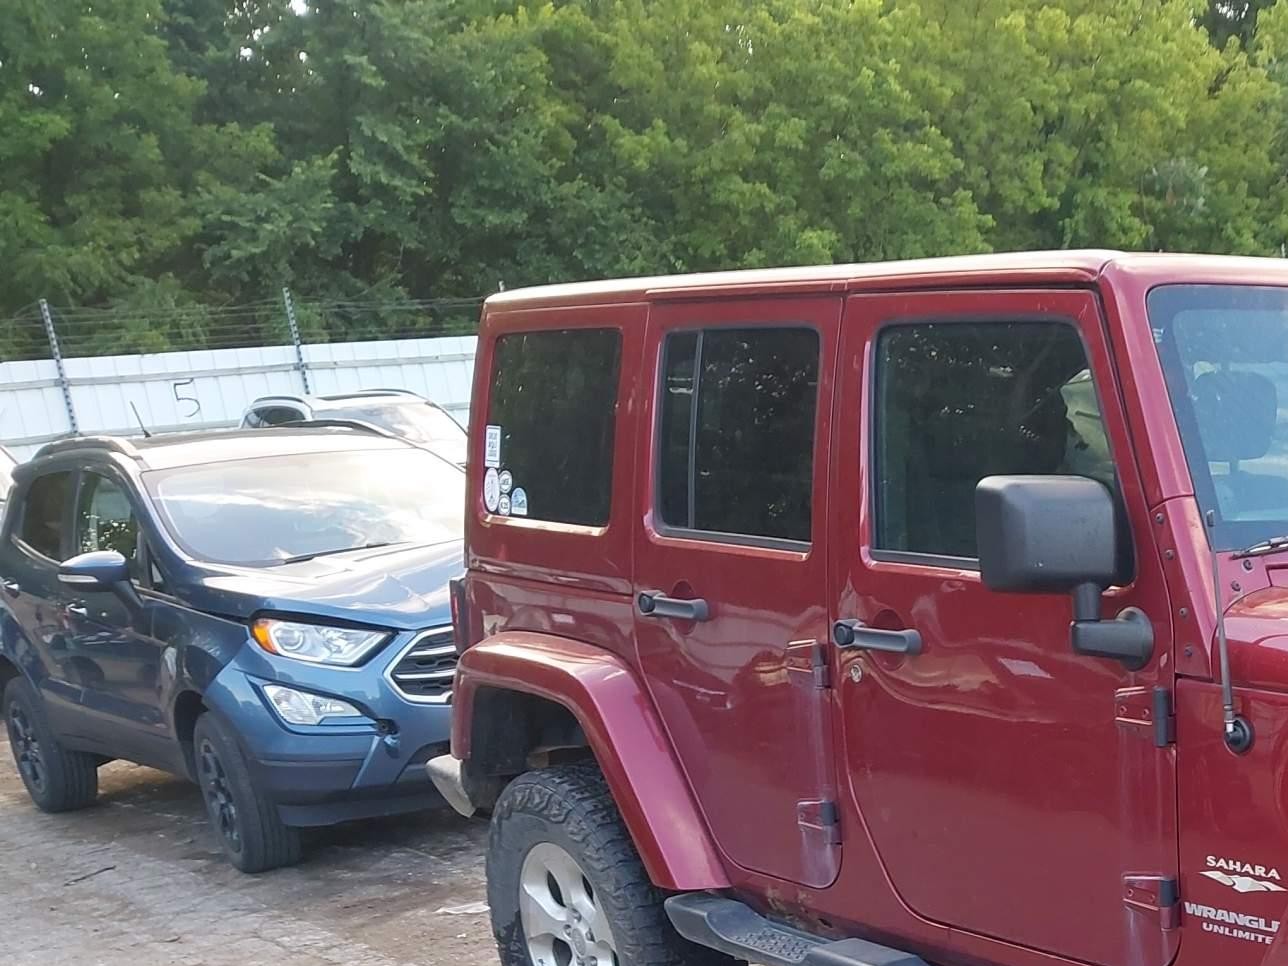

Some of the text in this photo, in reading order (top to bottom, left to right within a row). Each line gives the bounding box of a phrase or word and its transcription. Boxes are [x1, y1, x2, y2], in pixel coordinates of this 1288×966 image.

[173, 378, 201, 418] 5
[1206, 855, 1281, 880] SAHARA
[1184, 901, 1281, 933] WRANGL
[1202, 922, 1274, 945] UNLIMITE
